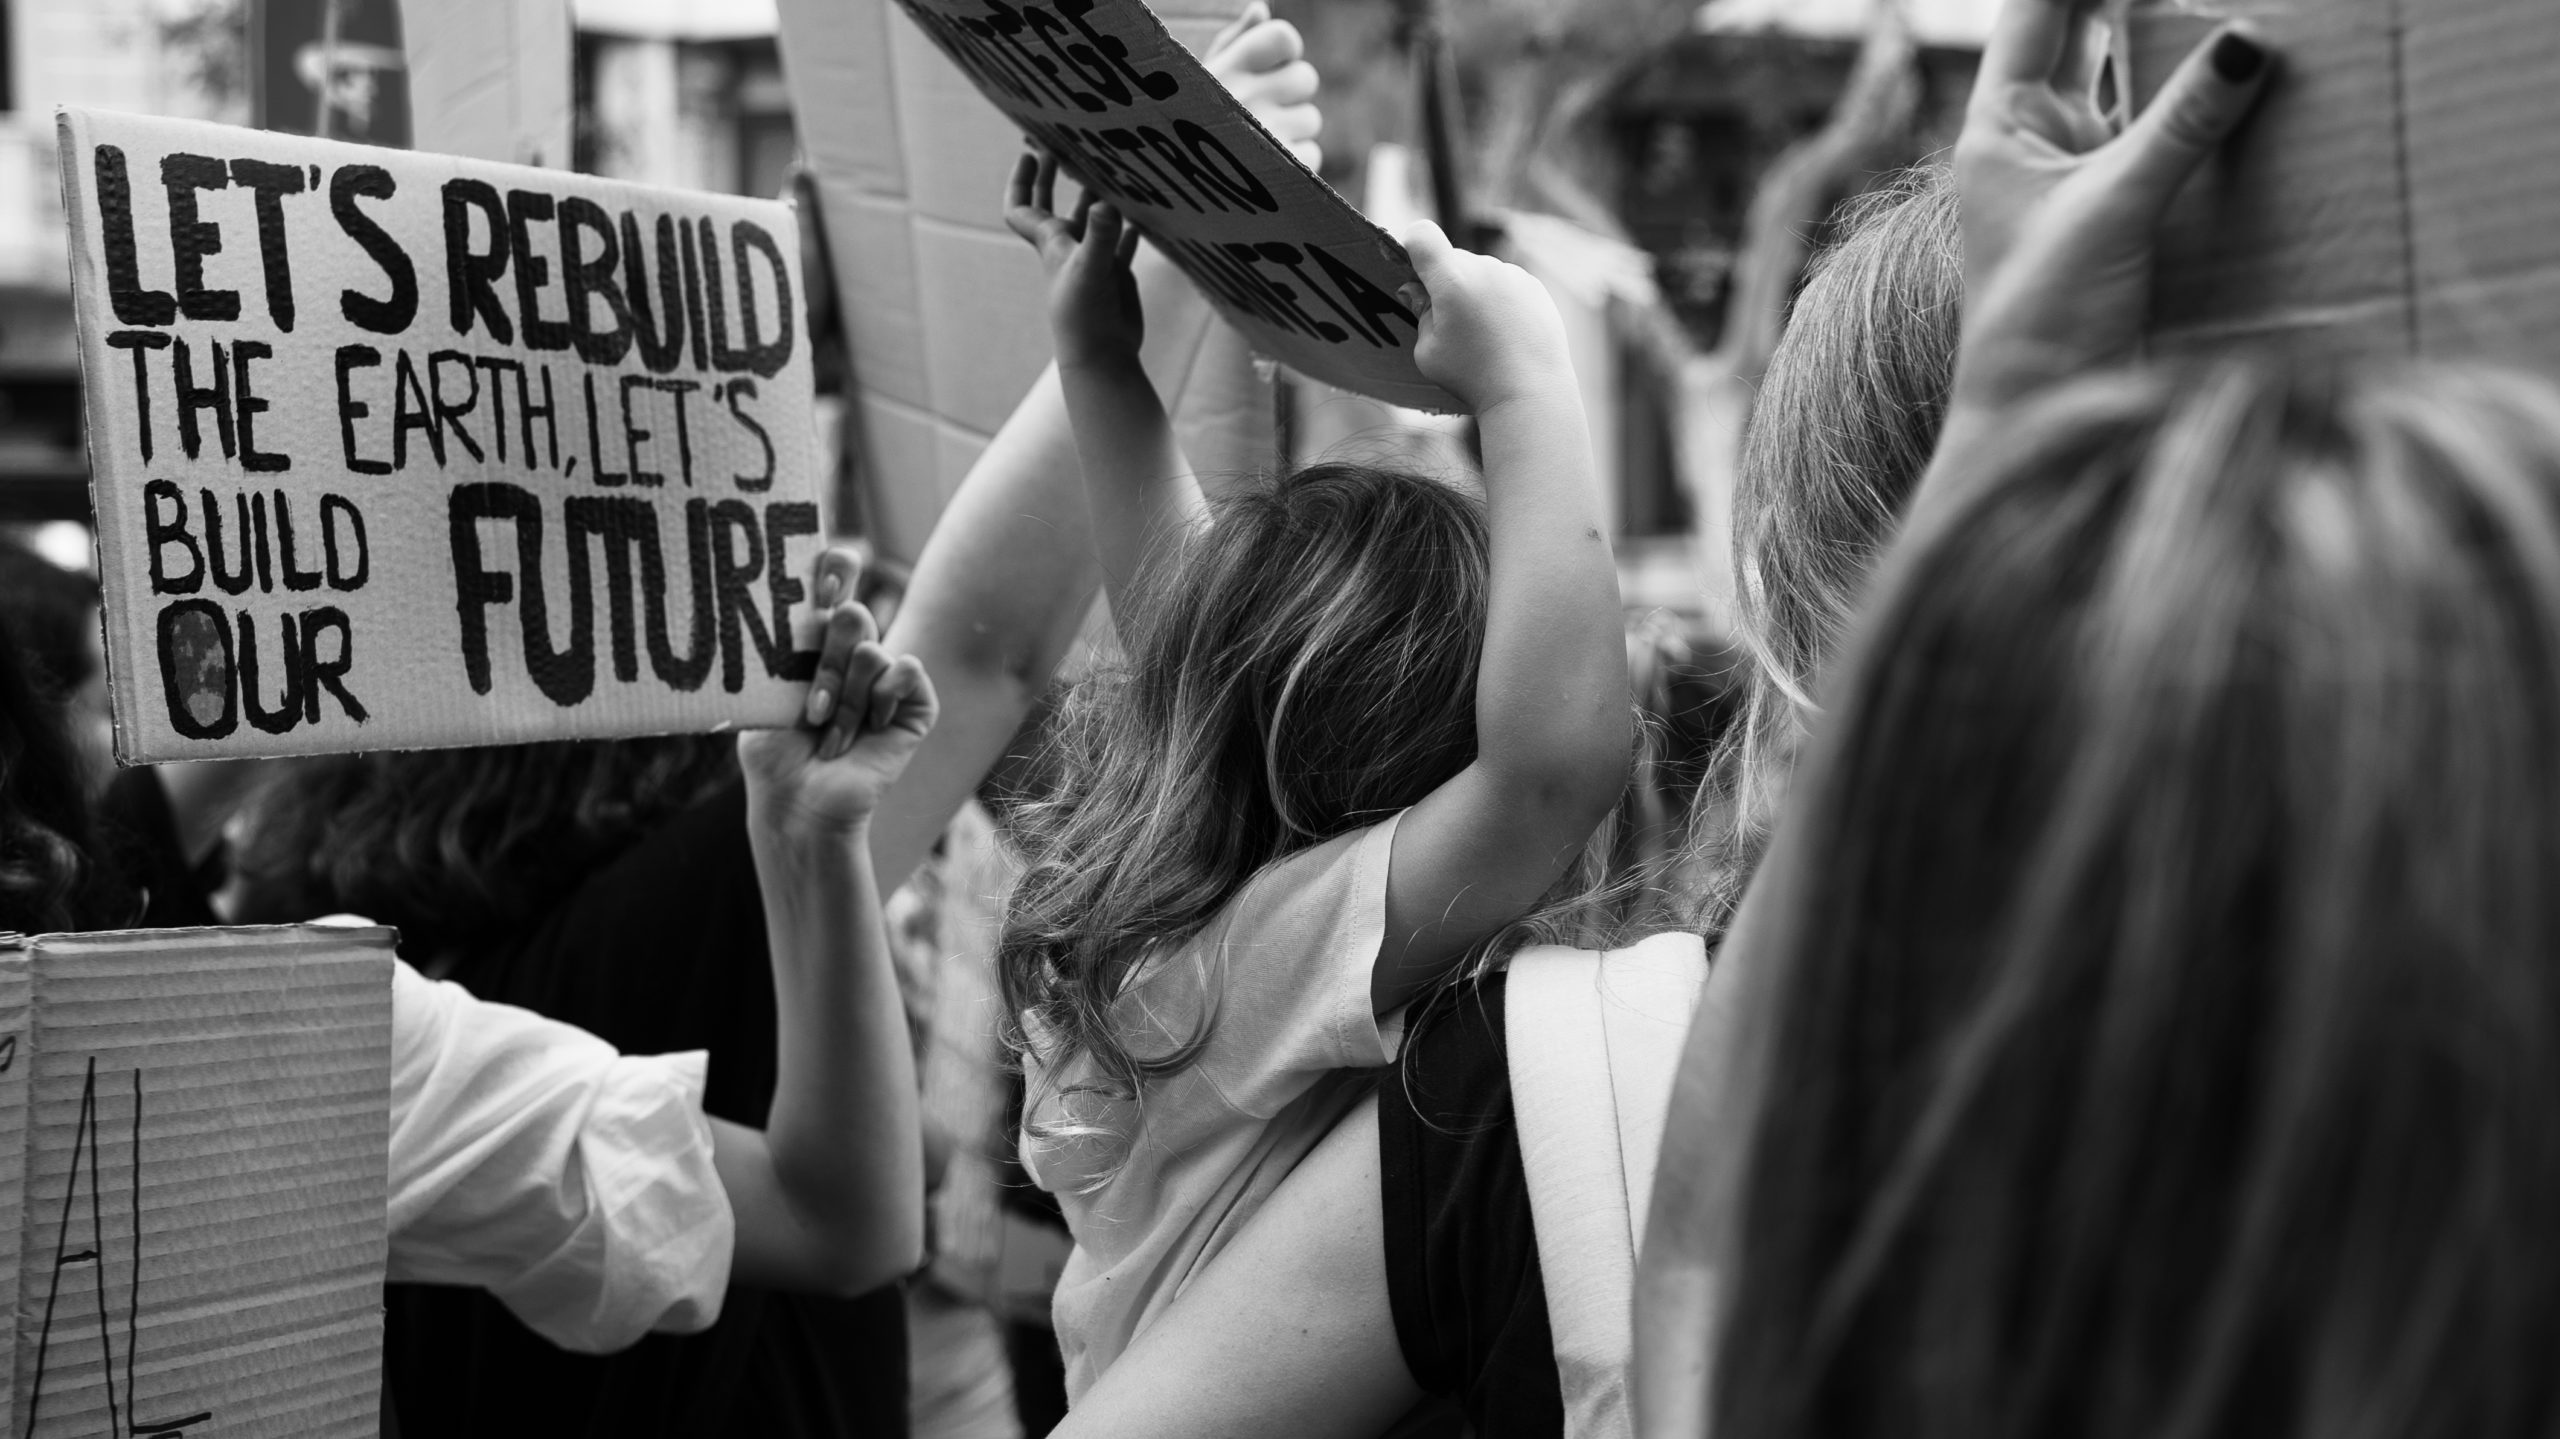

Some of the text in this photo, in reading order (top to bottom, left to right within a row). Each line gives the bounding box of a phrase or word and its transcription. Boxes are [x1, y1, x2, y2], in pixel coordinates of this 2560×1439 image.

[95, 144, 794, 379] LET'S REBUILD
[105, 330, 776, 493] THE EARTH, LET'S
[144, 478, 370, 596] BUILD
[157, 482, 821, 740] OUR FUTURE
